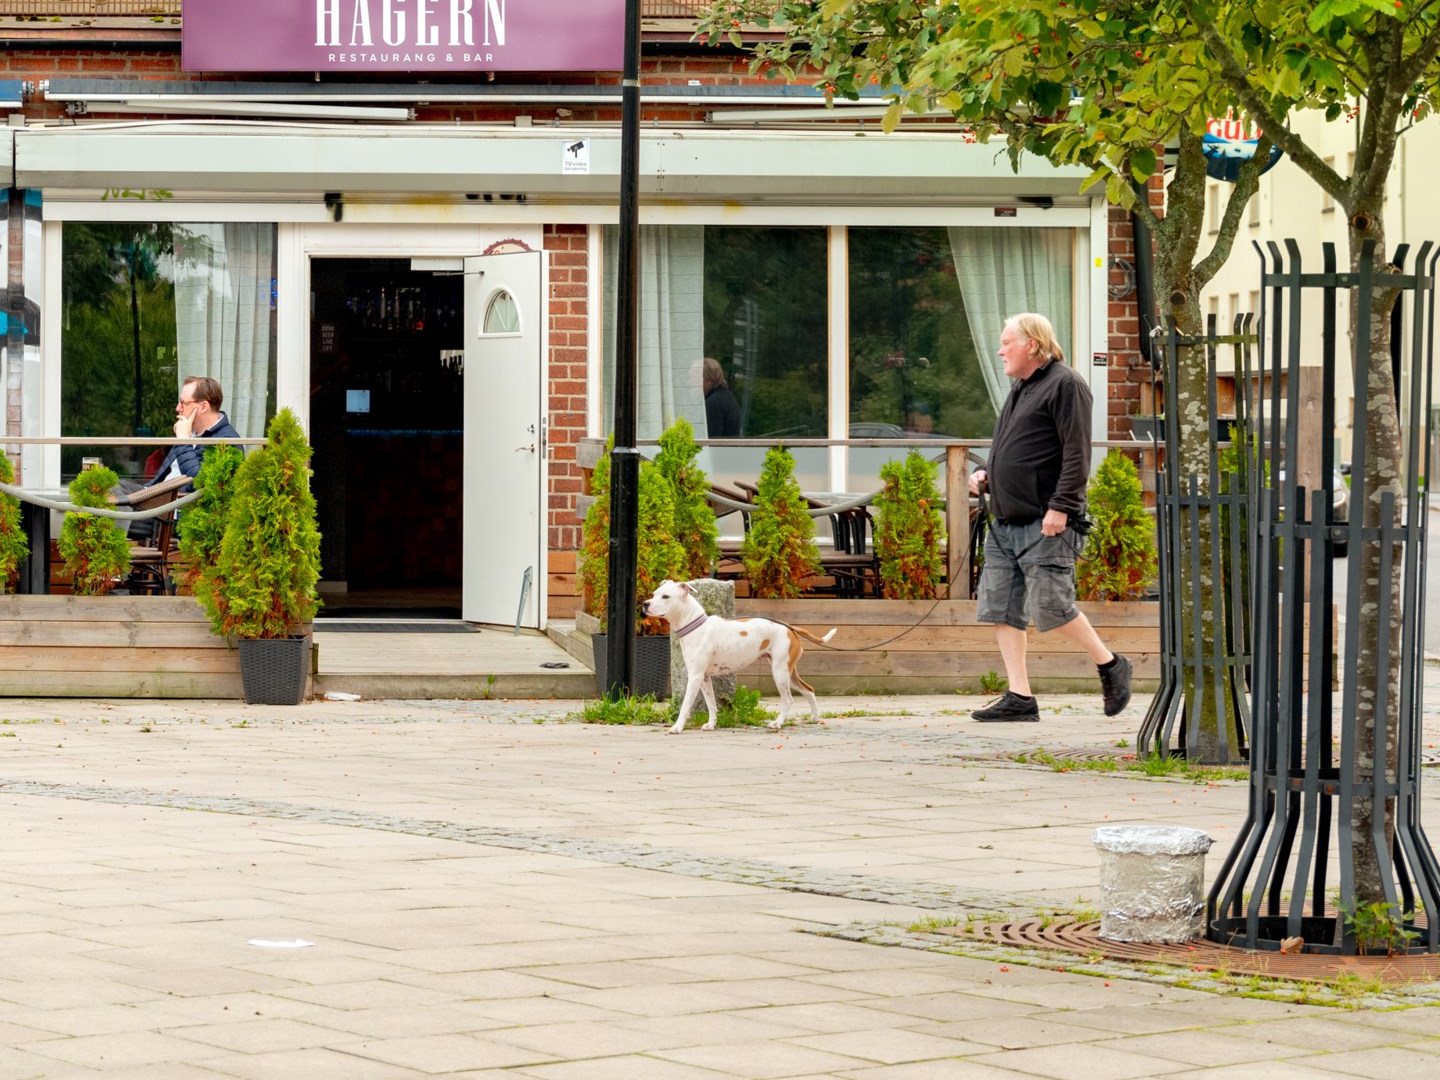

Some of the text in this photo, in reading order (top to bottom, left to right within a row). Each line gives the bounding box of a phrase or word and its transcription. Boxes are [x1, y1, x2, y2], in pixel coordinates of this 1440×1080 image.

[328, 53, 494, 62] RESTAURANG & BAR
